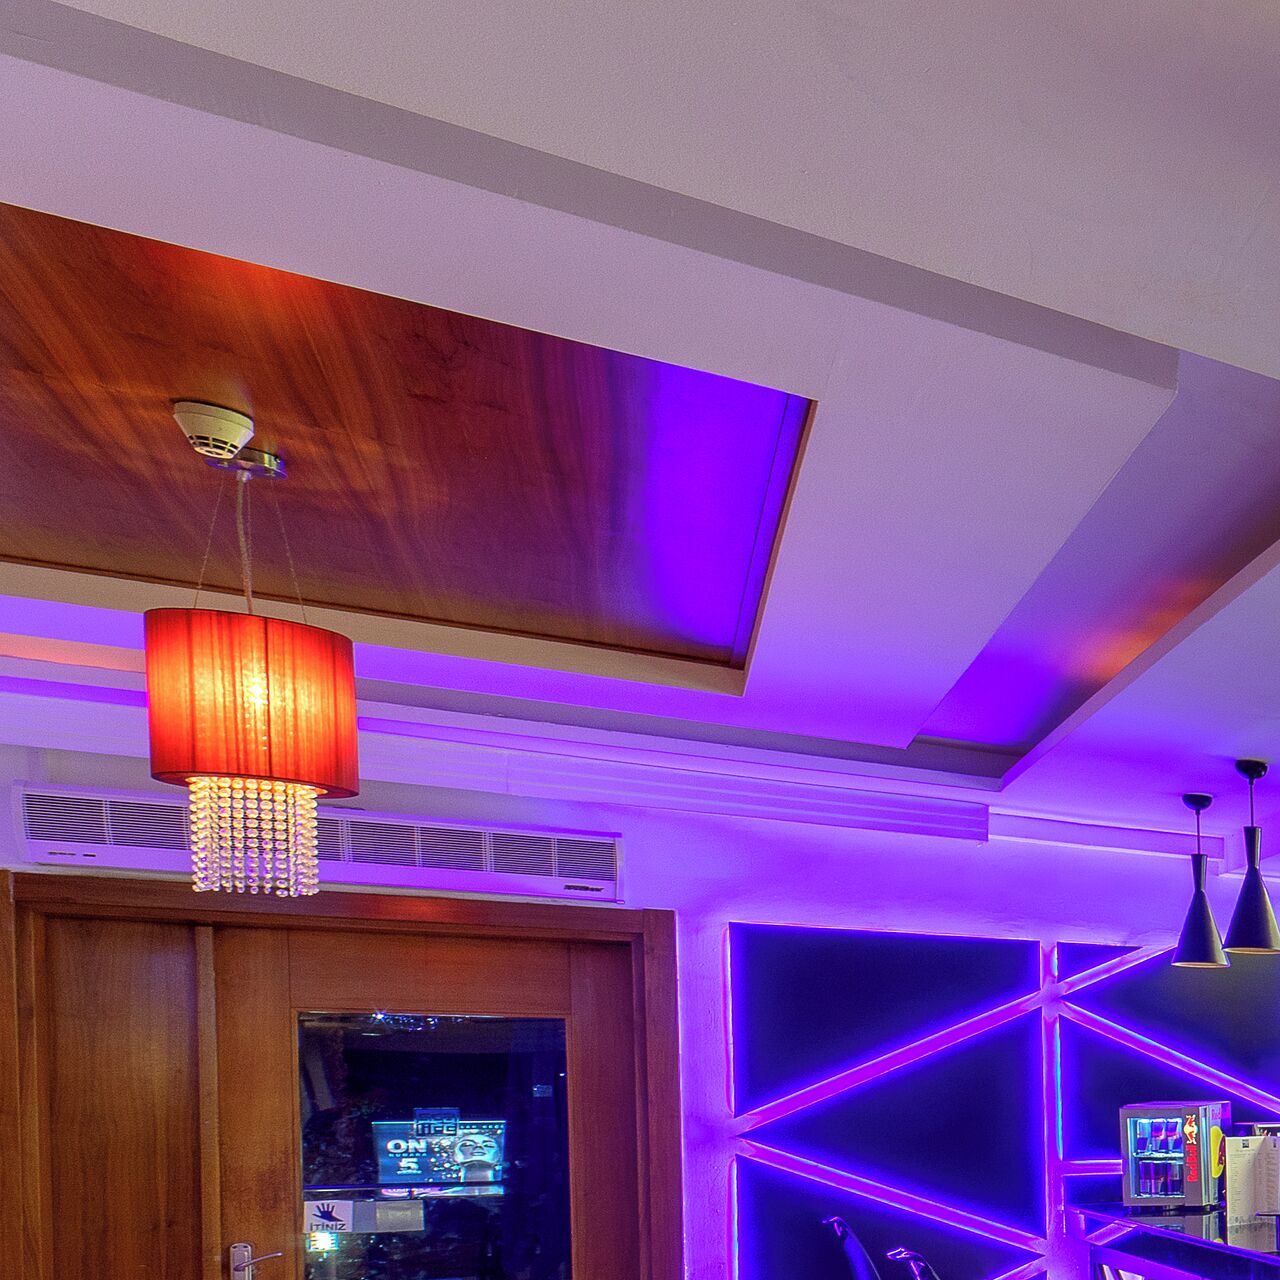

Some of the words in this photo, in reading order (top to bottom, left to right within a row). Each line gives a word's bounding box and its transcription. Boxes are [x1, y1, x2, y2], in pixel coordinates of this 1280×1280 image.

[387, 1139, 427, 1152] ON
[1185, 1144, 1198, 1163] Bull
[399, 1158, 419, 1170] 5
[1185, 1163, 1198, 1183] Red
